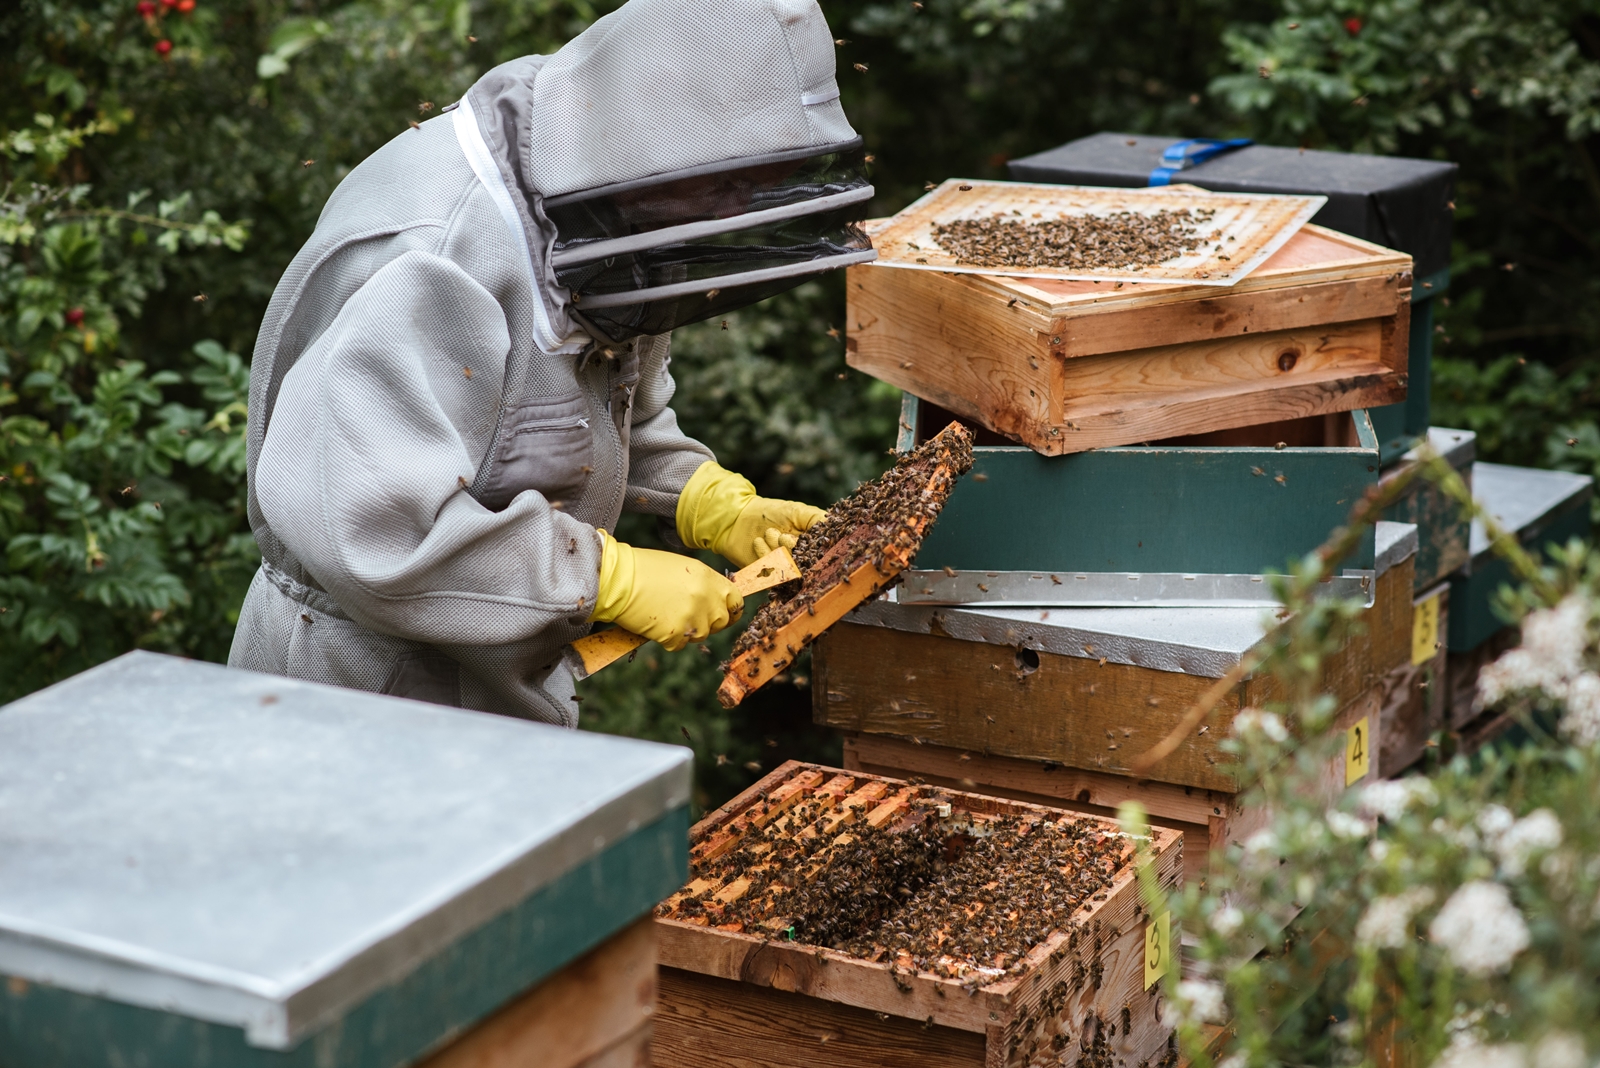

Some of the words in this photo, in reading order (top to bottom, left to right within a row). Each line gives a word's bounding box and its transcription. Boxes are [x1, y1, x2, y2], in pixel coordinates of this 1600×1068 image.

[1421, 606, 1431, 644] 5
[1352, 729, 1363, 766] 4
[1150, 924, 1161, 970] 3
